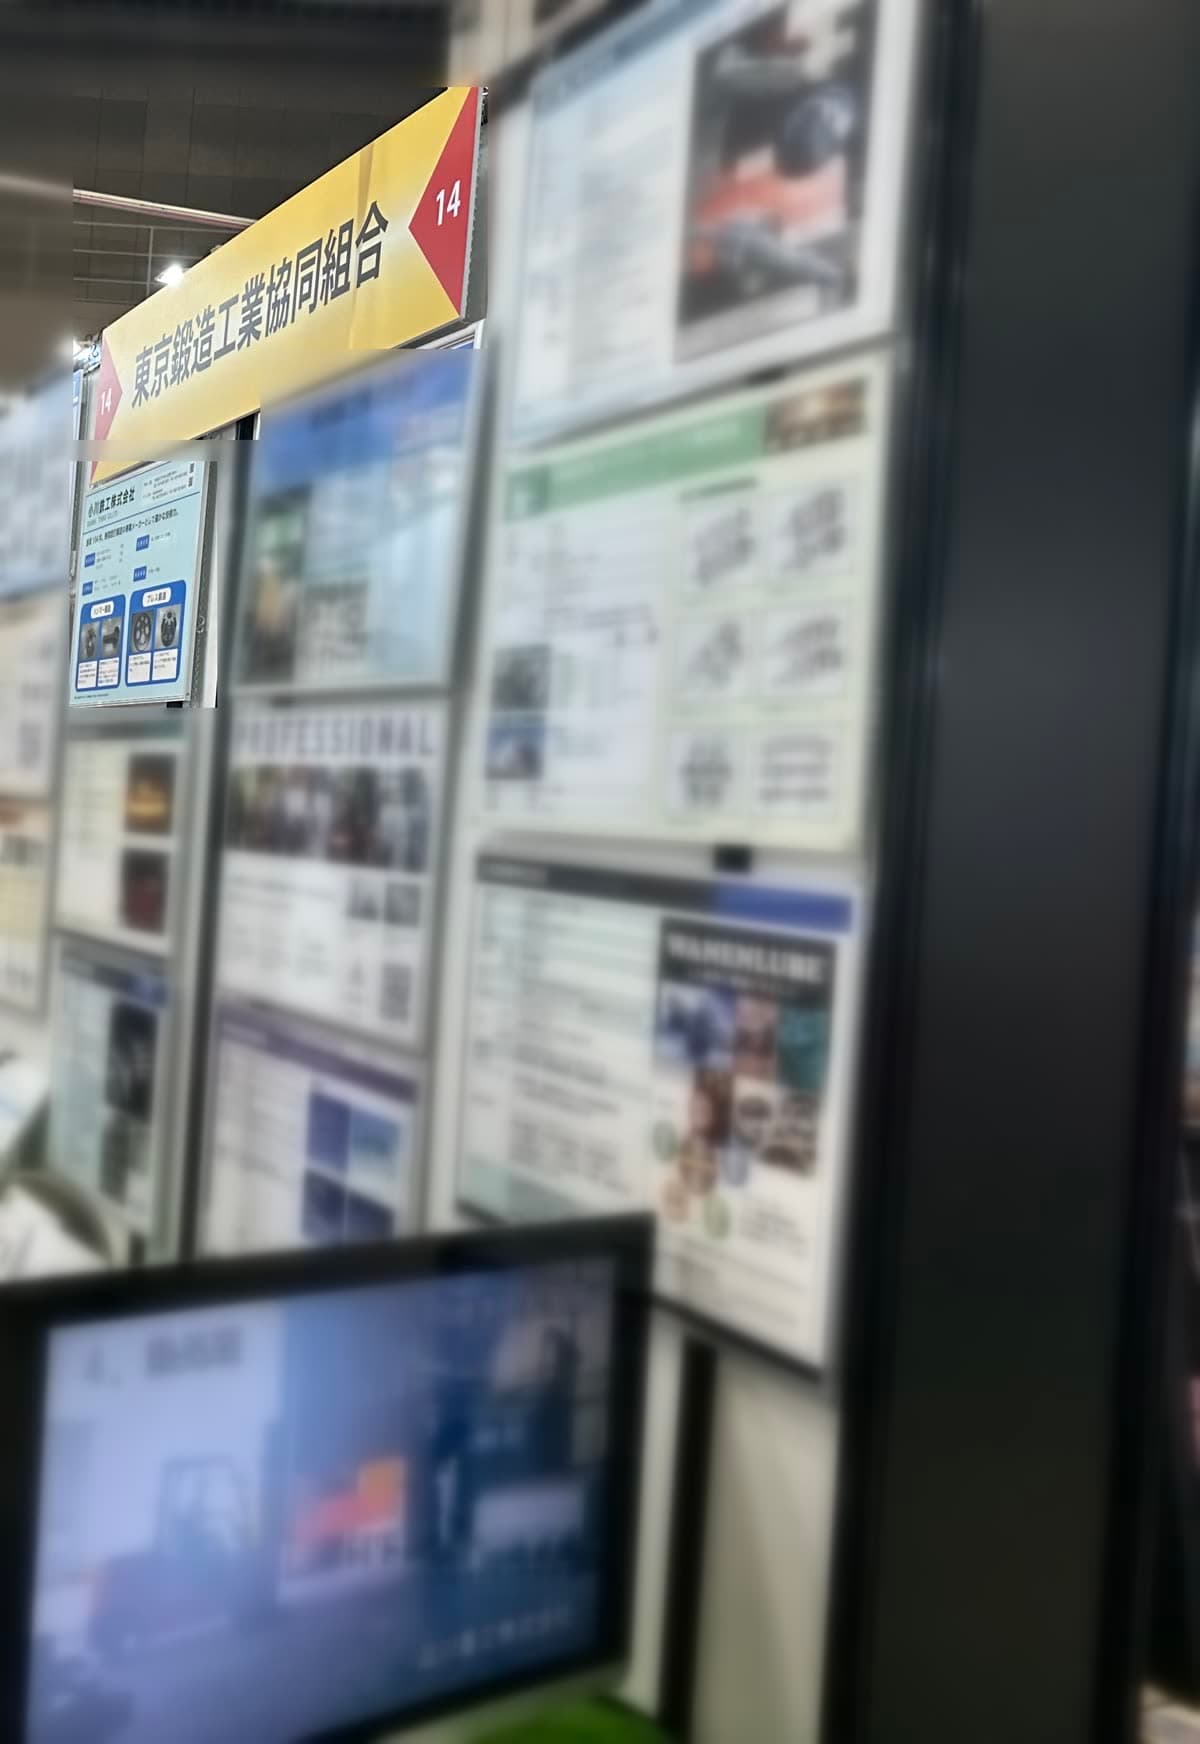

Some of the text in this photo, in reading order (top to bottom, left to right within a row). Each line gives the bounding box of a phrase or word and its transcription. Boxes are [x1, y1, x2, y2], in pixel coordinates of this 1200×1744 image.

[434, 180, 462, 227] 14
[131, 200, 390, 409] 東京鍛造工業協同組合
[100, 388, 113, 416] 14
